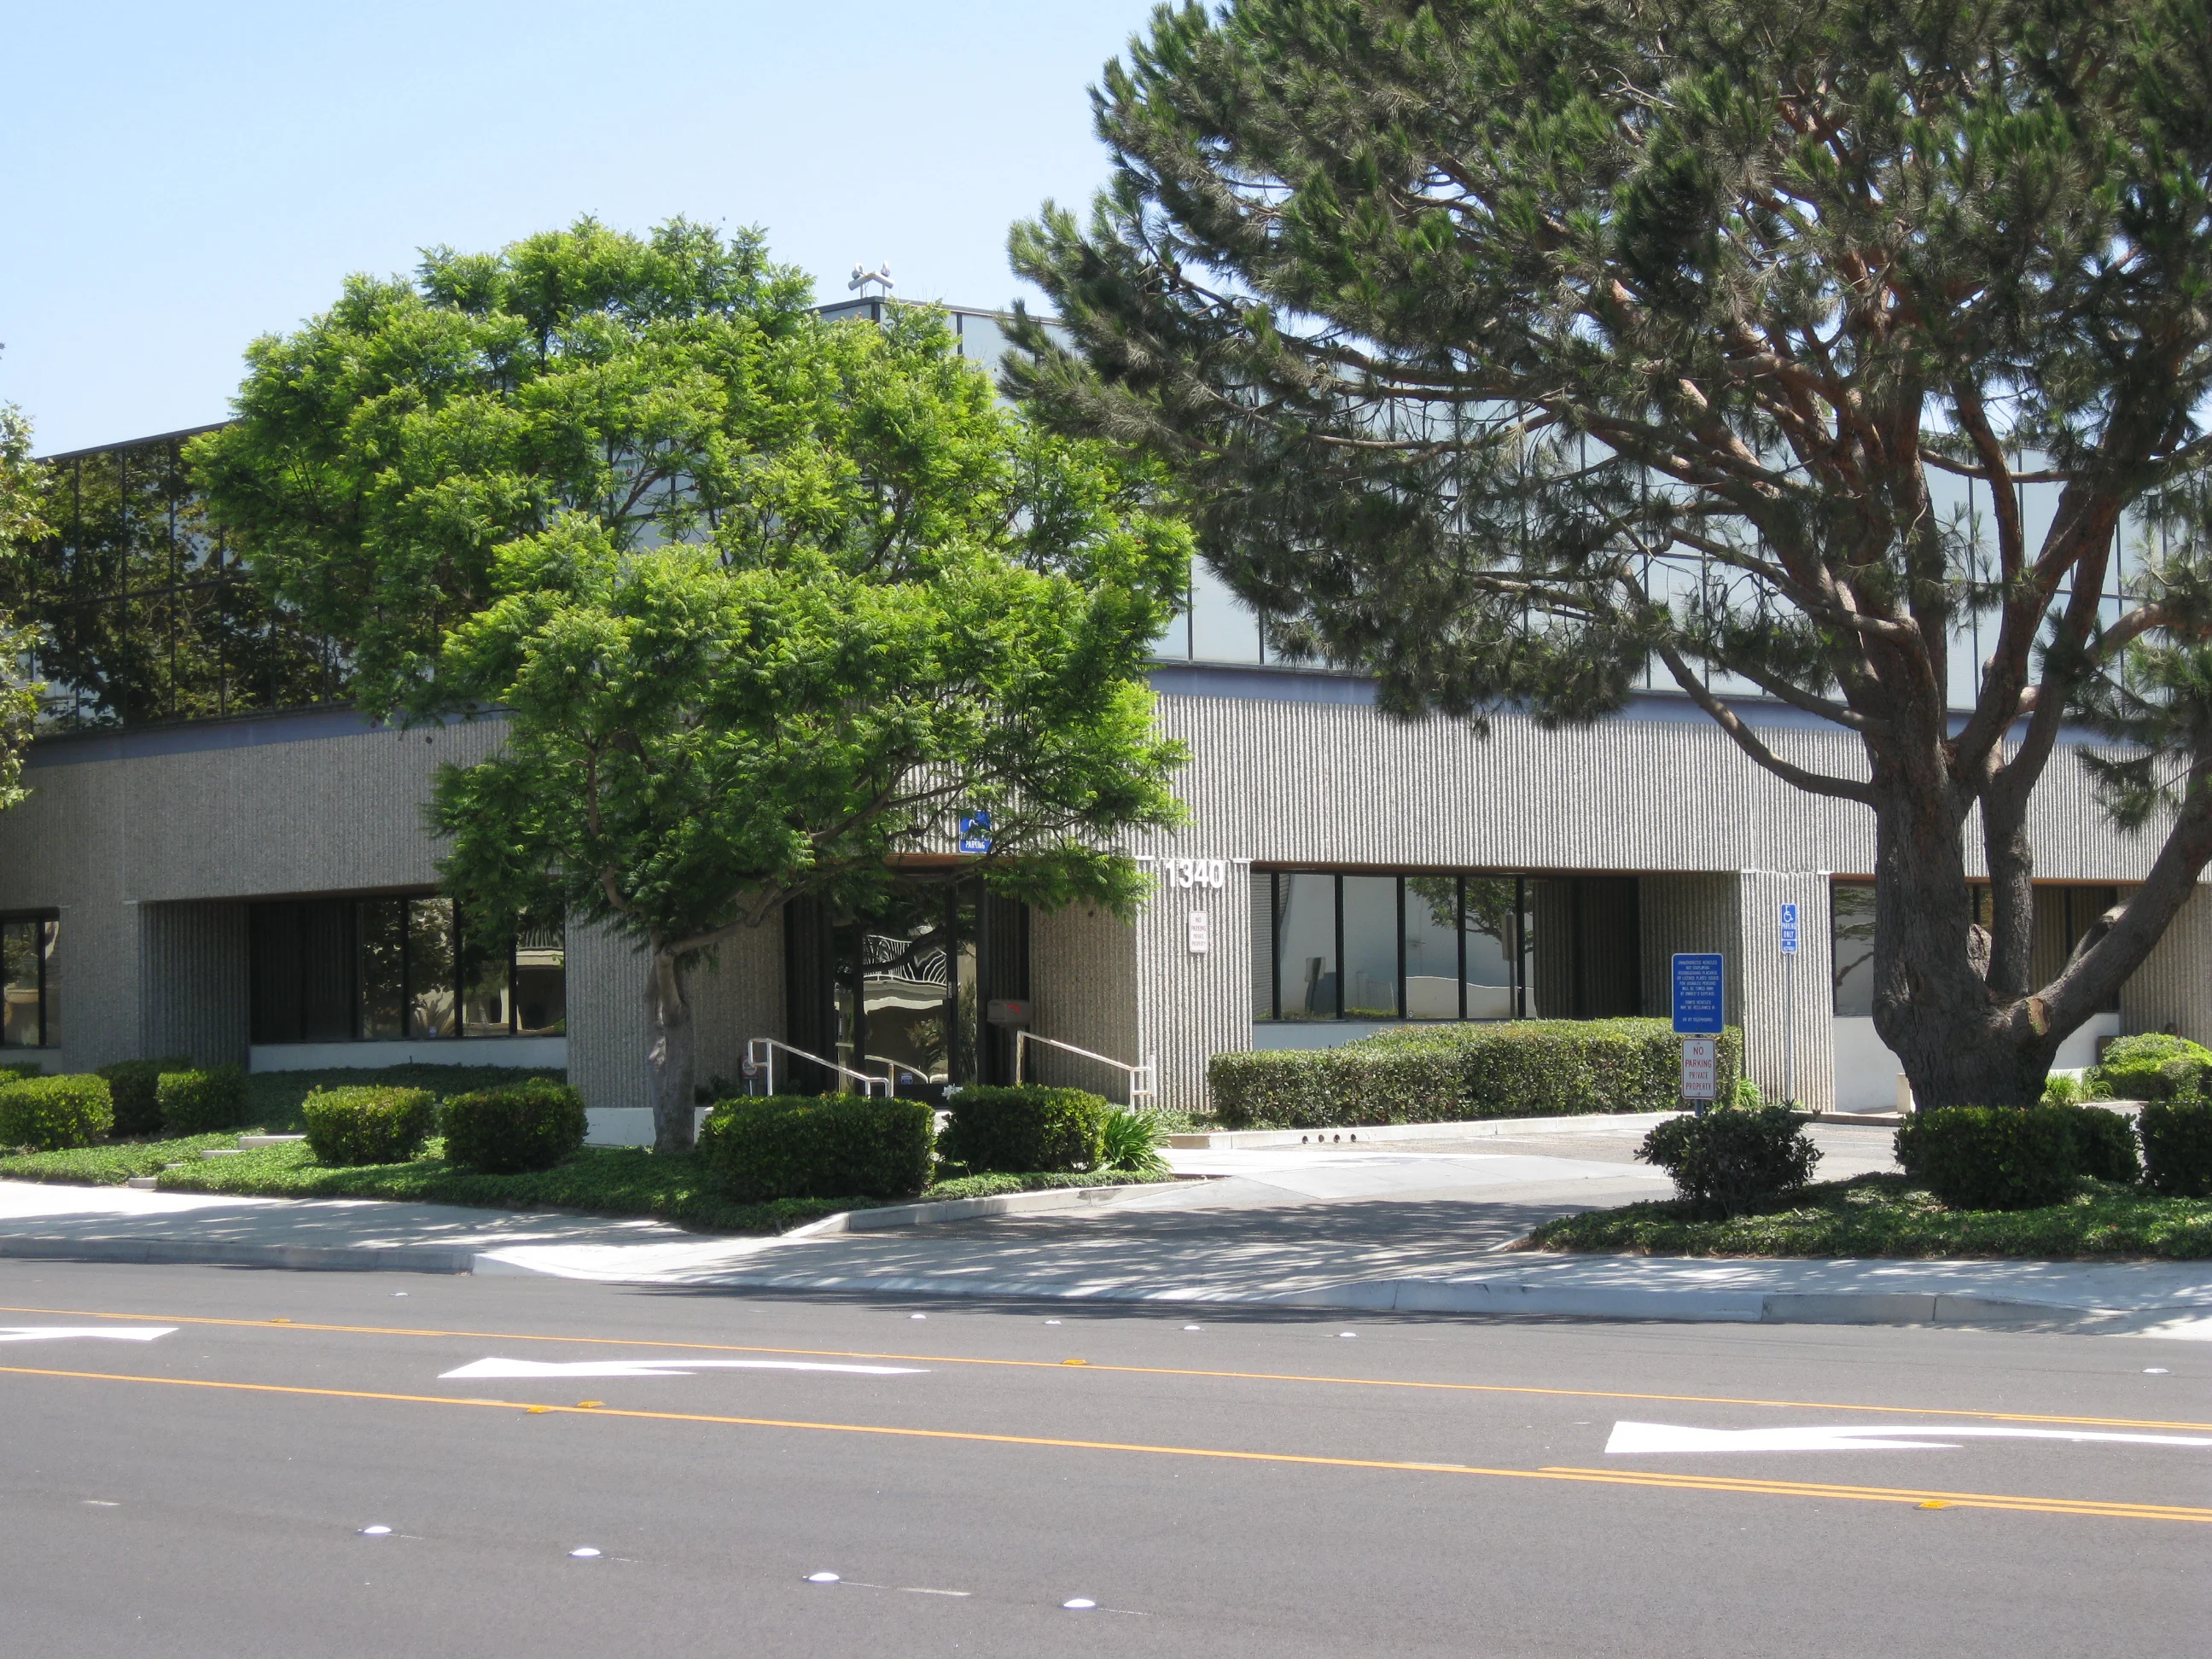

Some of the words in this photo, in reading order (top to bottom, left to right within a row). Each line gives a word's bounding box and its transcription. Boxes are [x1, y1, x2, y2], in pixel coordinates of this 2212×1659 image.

[965, 841, 986, 849] PARKING
[1165, 859, 1225, 888] 1340
[1693, 1046, 1704, 1055] NO
[1685, 1059, 1712, 1068] PARKING
[1689, 1071, 1708, 1079] PRIVATE
[1685, 1082, 1711, 1090] PROPERTY
